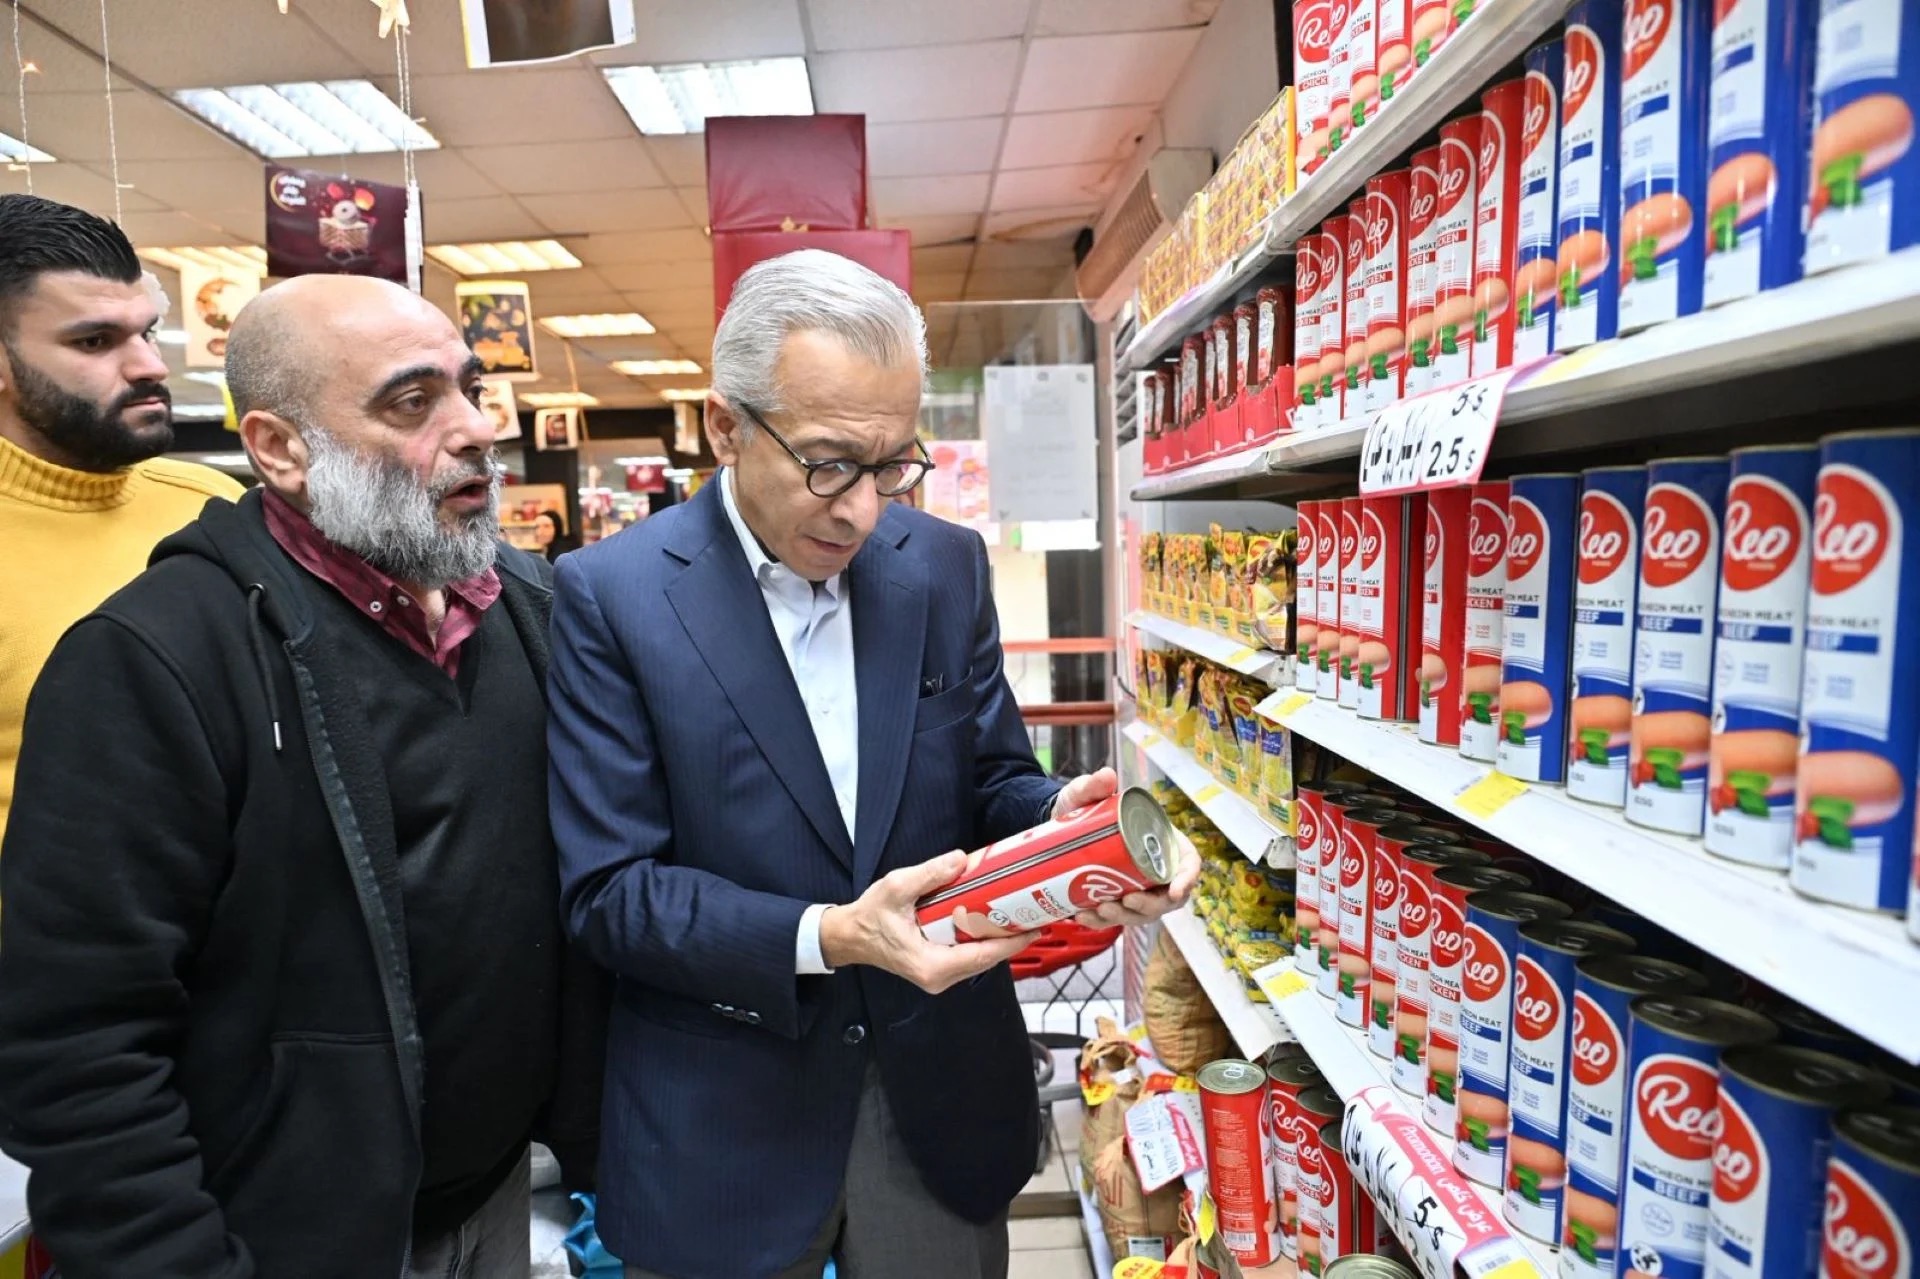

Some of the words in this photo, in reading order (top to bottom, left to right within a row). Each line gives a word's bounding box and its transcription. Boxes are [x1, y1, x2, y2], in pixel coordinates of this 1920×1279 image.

[1300, 17, 1329, 49] Re
[1447, 219, 1467, 229] MEAT
[1419, 241, 1436, 251] MEAT
[1482, 588, 1504, 596] MEAT
[1517, 595, 1539, 603] MEAT
[1597, 600, 1625, 608] MEAT
[1670, 605, 1704, 614] MEAT
[1756, 611, 1792, 621] MEAT
[1381, 921, 1396, 929] MEAT
[1410, 948, 1428, 959] MEAT
[1445, 978, 1460, 989] MEA
[1479, 1016, 1502, 1028] MEAT
[1530, 1056, 1555, 1069] MEAT
[1588, 1103, 1613, 1118] MEAT
[1642, 1074, 1725, 1138] Reo
[1399, 1126, 1446, 1176] Promotion
[1633, 1154, 1693, 1185] LUNCHEON
[1655, 1180, 1700, 1206] BEEF
